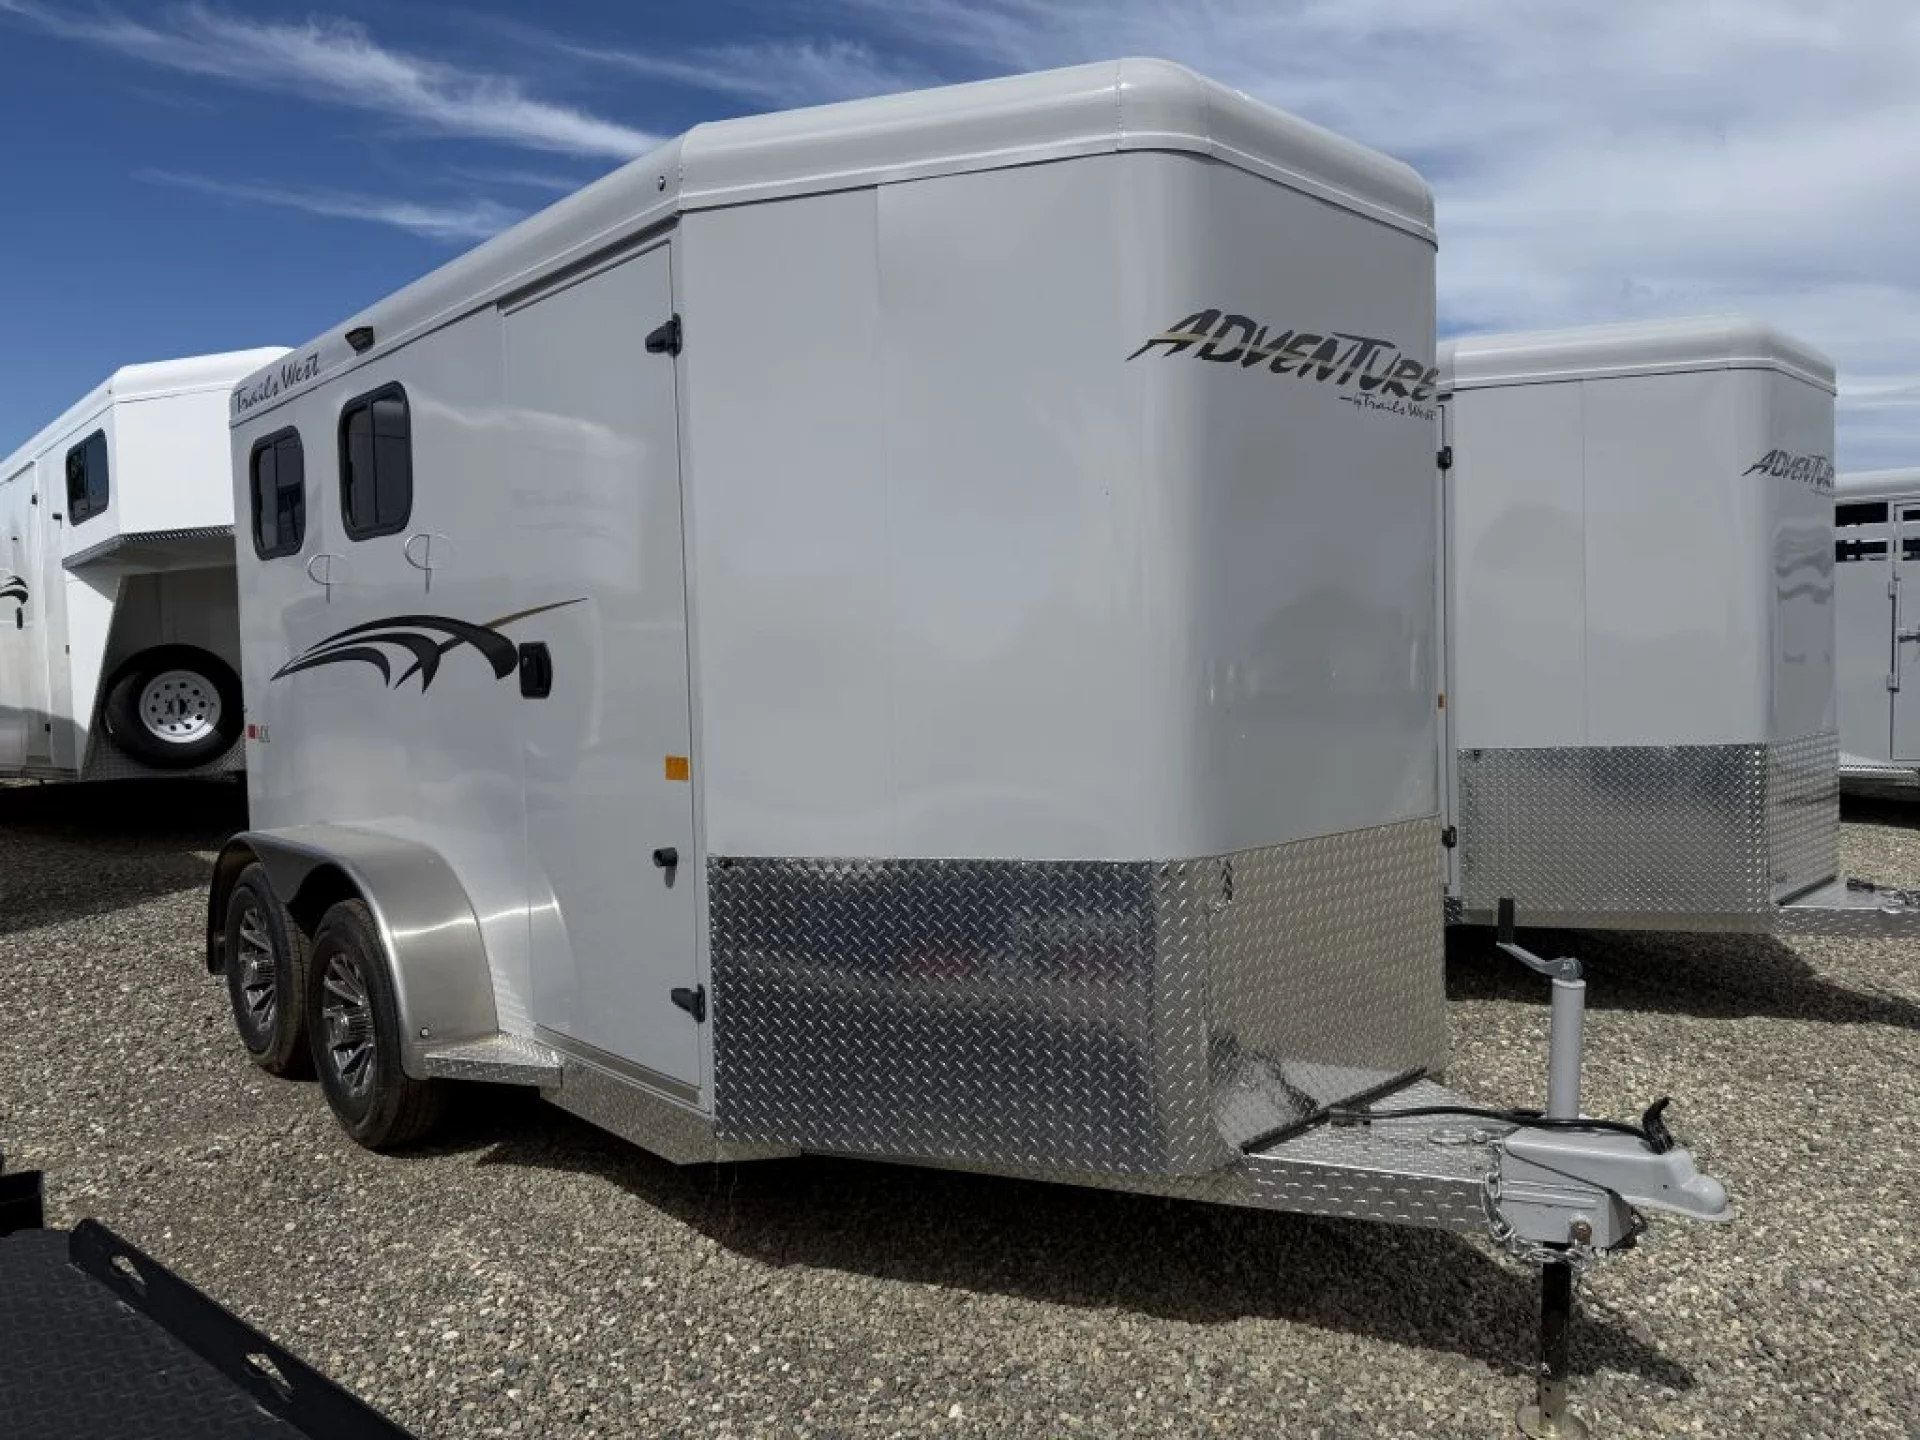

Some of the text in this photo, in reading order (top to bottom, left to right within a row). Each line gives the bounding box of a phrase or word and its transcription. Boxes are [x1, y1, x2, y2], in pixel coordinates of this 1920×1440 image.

[235, 352, 319, 413] Trails West
[1360, 392, 1405, 415] Trails
